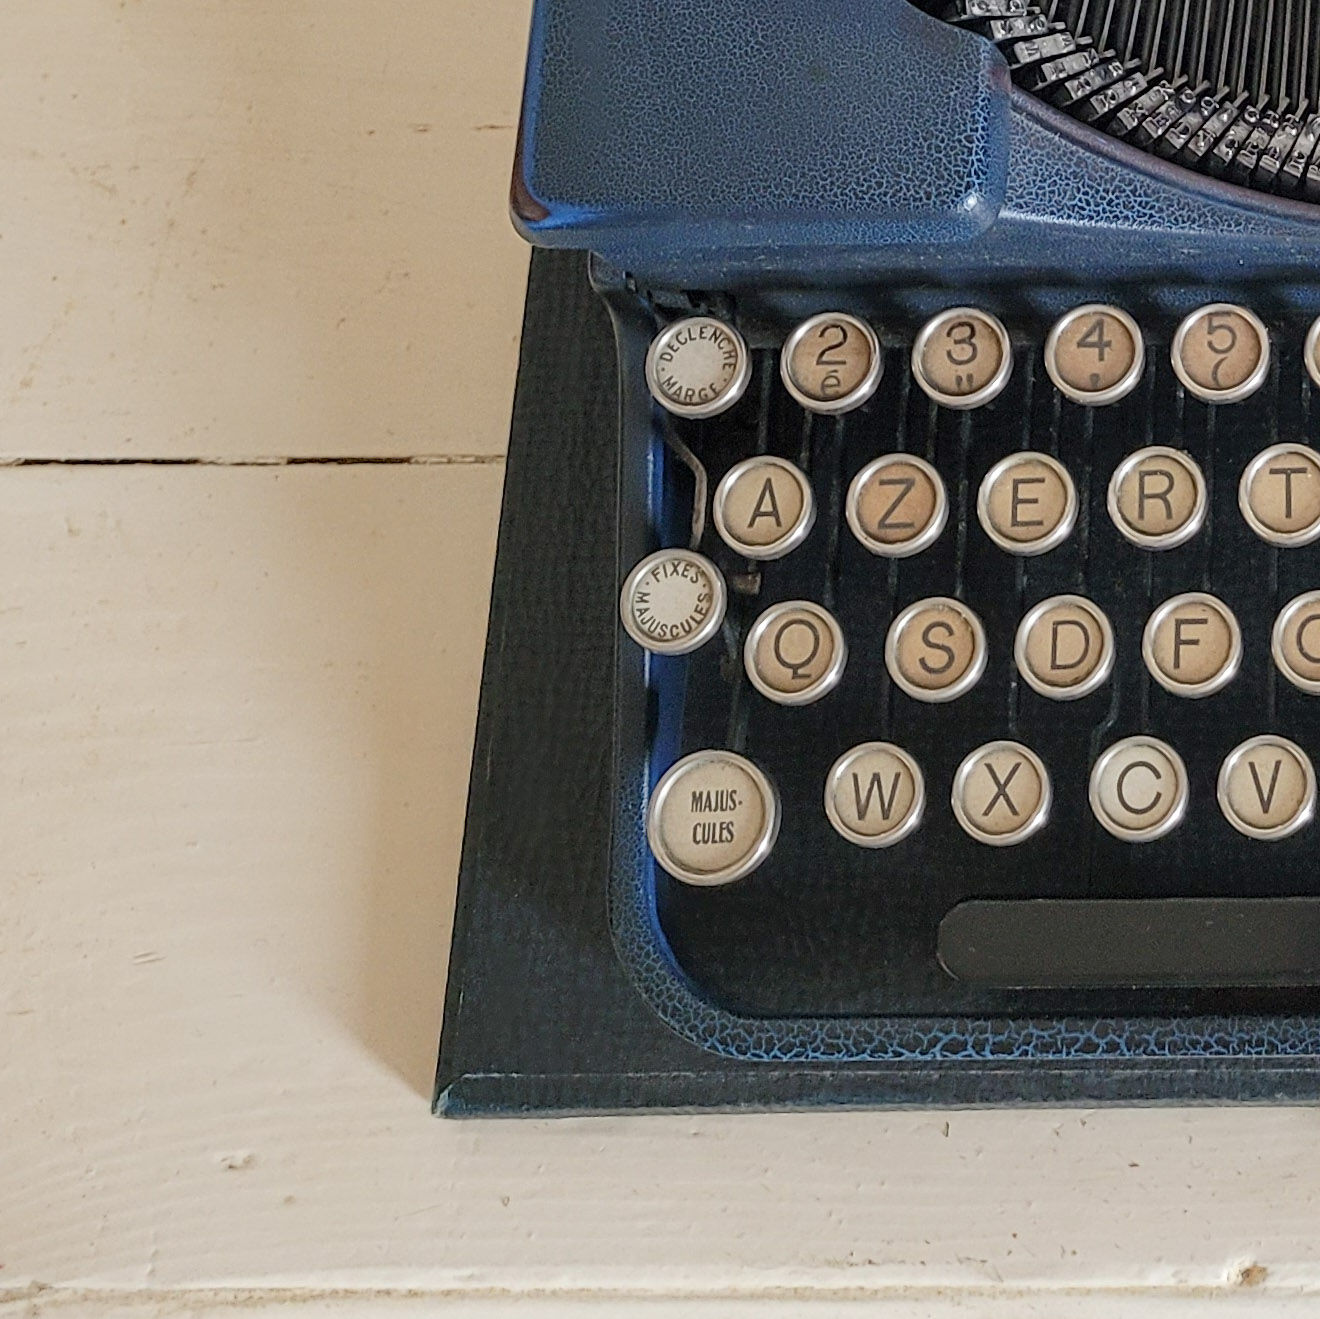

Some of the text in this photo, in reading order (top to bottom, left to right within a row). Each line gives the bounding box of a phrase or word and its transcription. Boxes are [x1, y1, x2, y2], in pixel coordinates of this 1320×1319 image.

[659, 326, 738, 371] DECLENCHE
[815, 323, 848, 367] 2
[945, 320, 977, 365] 3
[1076, 318, 1113, 362] 4
[1205, 313, 1238, 355] 5
[662, 375, 721, 402] MARGE
[819, 369, 841, 397] é
[746, 476, 783, 529] A
[877, 477, 916, 531] Z
[1009, 476, 1047, 528] E
[1137, 468, 1175, 521] R
[1268, 466, 1308, 519] T
[650, 561, 701, 585] FIXES
[634, 590, 709, 639] MAJUSCULES
[773, 617, 821, 680] Q
[917, 620, 956, 675] S
[1049, 619, 1091, 671] D
[1172, 617, 1209, 671] F
[851, 770, 902, 822] W
[982, 761, 1023, 818] X
[1115, 759, 1163, 816] C
[1247, 758, 1283, 815] V
[691, 820, 735, 845] CULES
